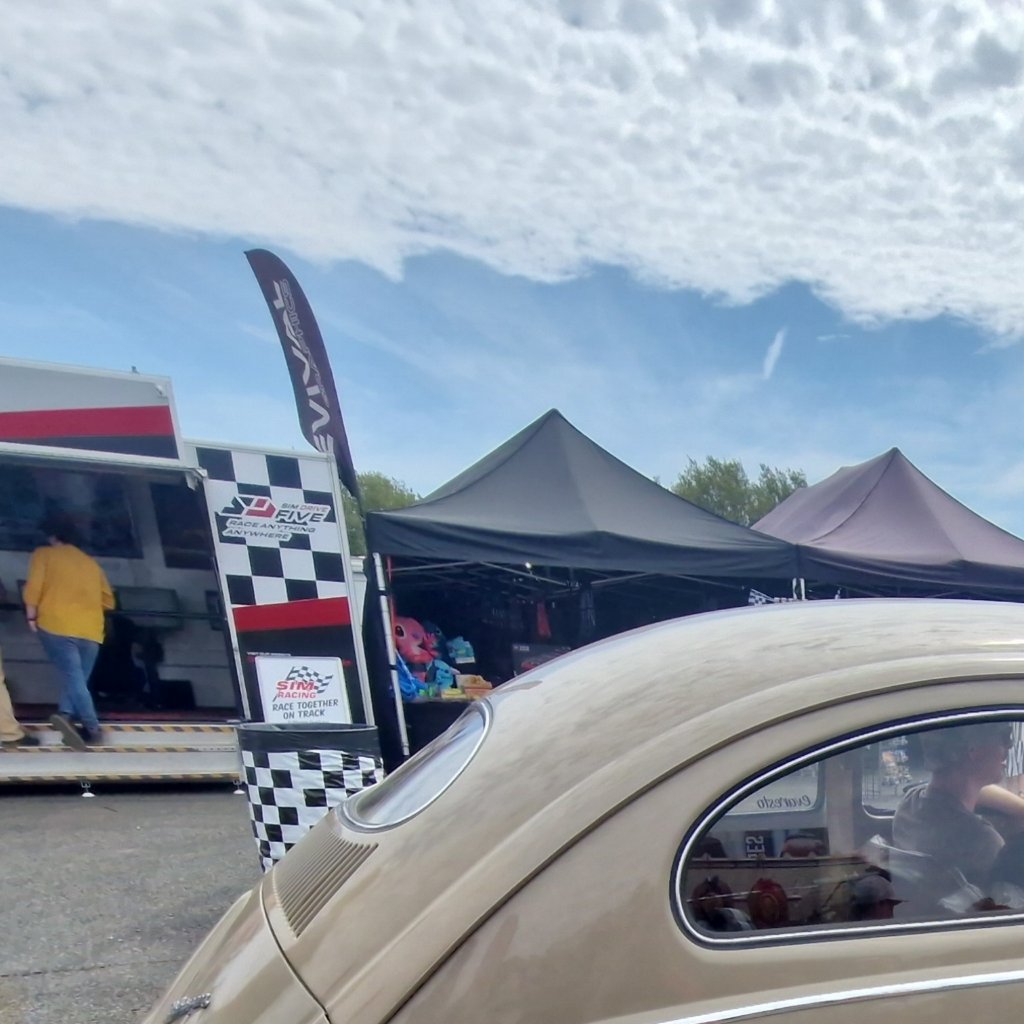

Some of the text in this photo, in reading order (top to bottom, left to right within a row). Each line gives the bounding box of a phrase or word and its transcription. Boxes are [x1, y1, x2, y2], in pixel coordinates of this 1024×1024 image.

[273, 280, 334, 453] EVIVAL
[276, 510, 324, 521] FIVE
[229, 520, 316, 533] RACE ANYTHING
[226, 529, 290, 540] ANYWHERE
[276, 681, 315, 690] SIM
[276, 691, 316, 699] RACING
[272, 699, 339, 711] RACE TOGETHER
[297, 709, 325, 718] TRACK
